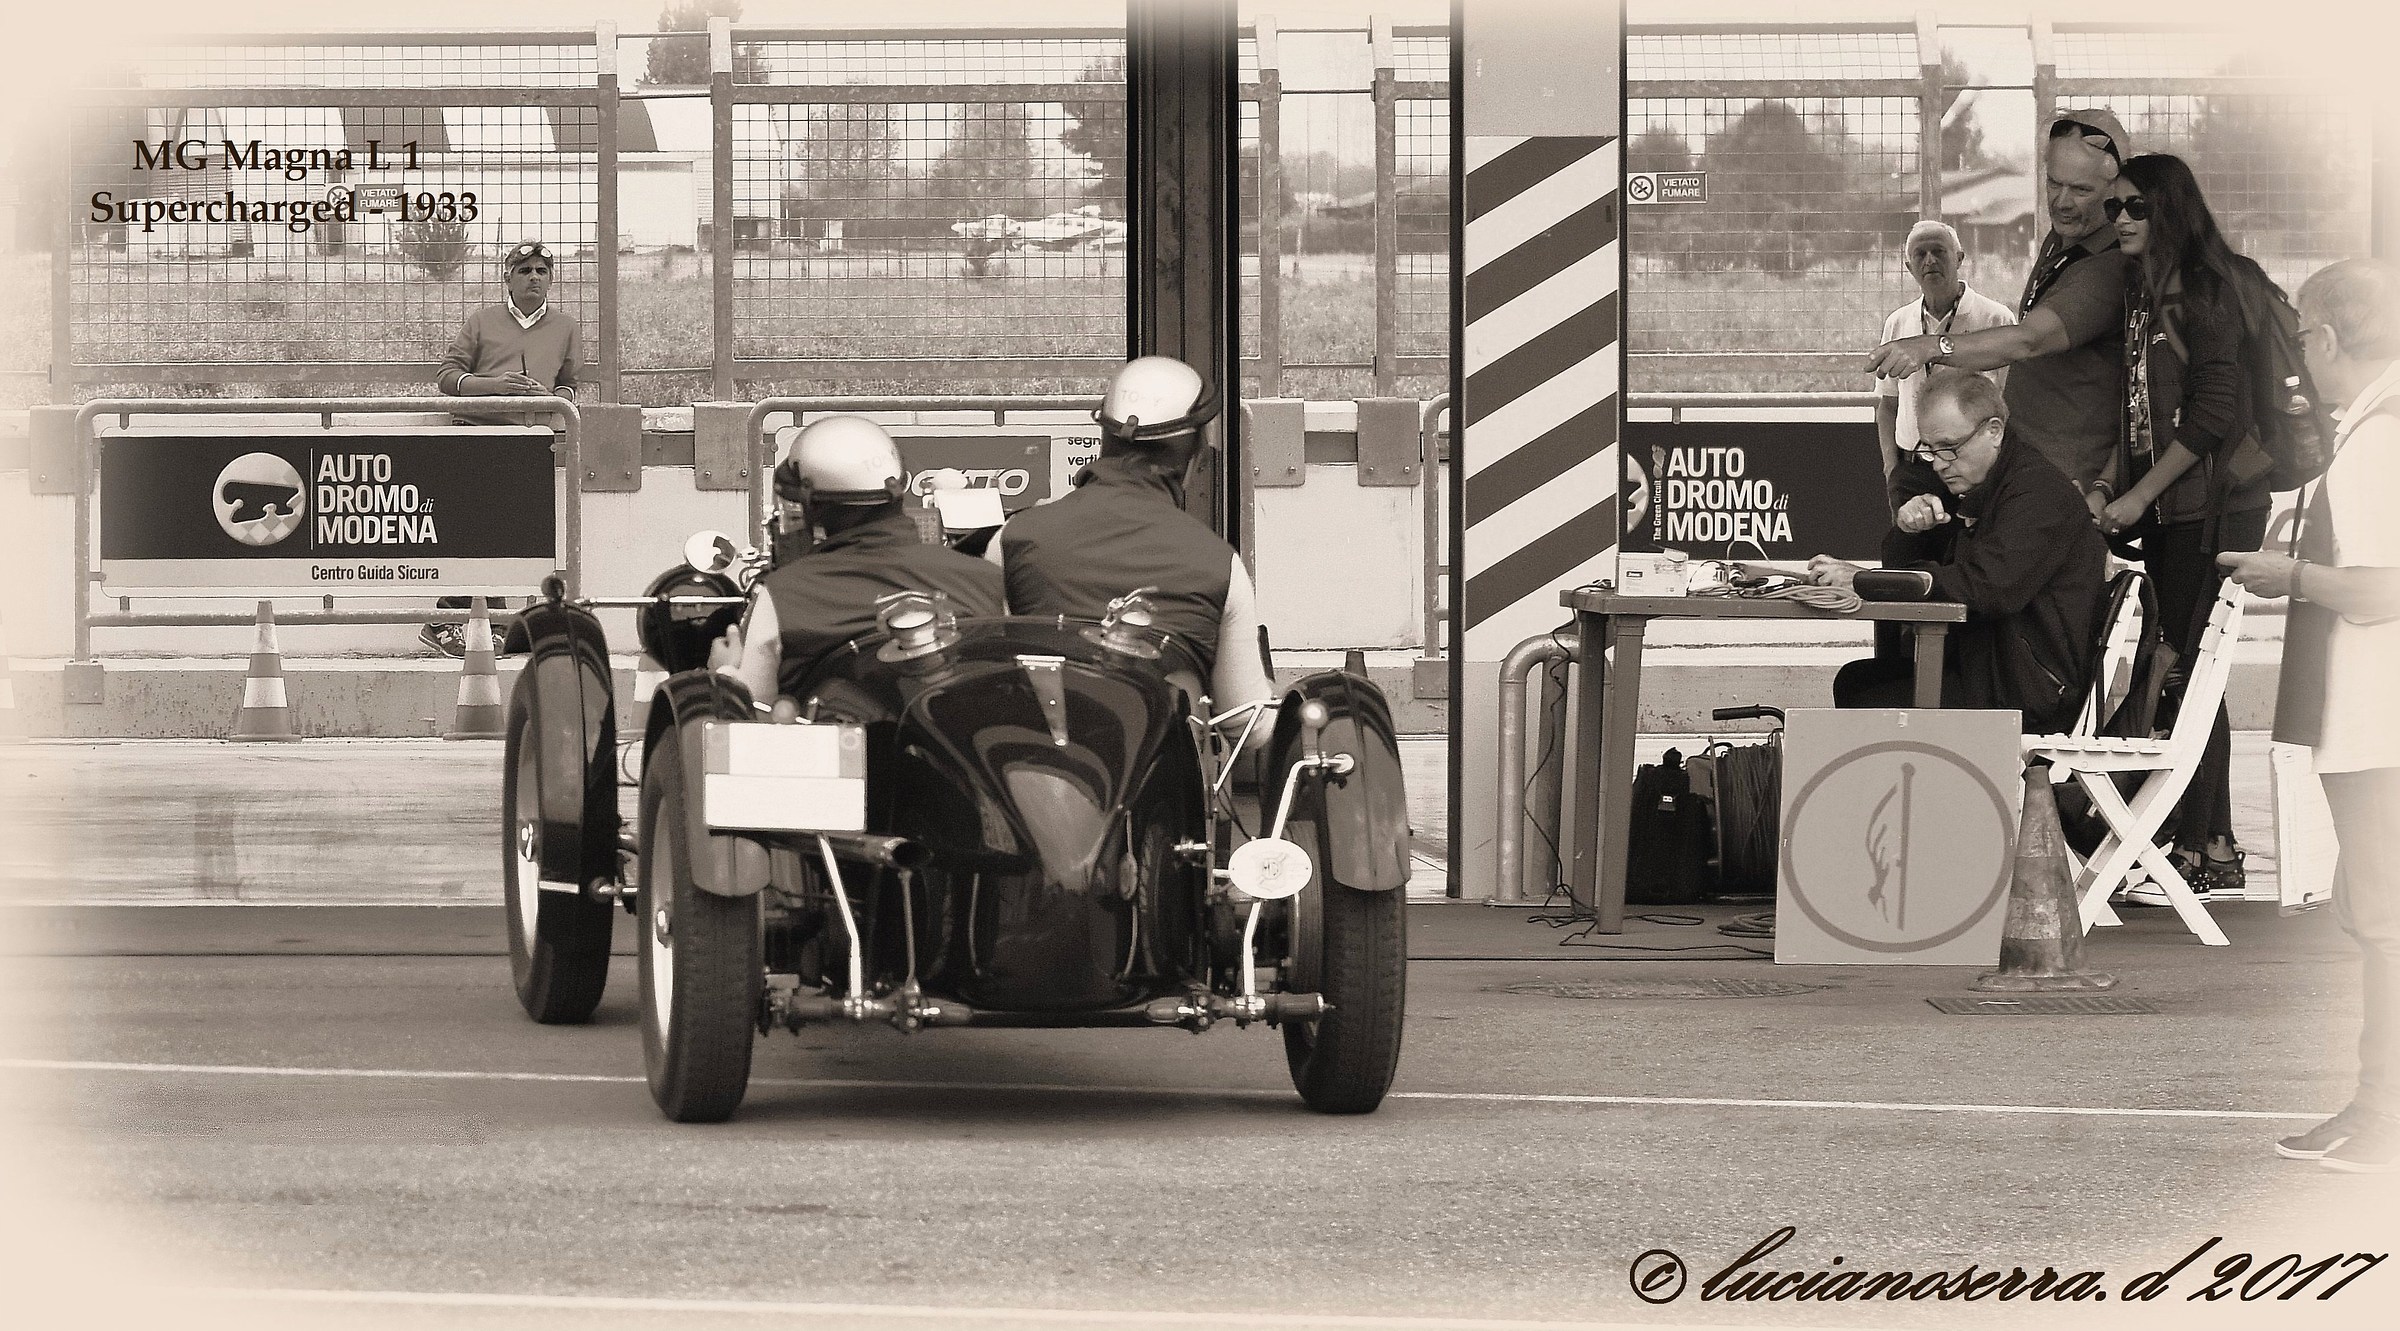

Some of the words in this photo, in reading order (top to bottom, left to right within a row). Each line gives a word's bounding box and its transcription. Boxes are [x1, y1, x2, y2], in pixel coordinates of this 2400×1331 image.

[360, 188, 398, 197] VIETATO
[1661, 188, 1700, 197] FUMARE
[1662, 177, 1700, 187] VIETATO
[359, 198, 399, 208] FUMARE
[317, 453, 392, 483] AUTO
[1667, 447, 1745, 478] AUTO
[317, 484, 419, 513] DROMO
[419, 498, 434, 513] di
[1667, 479, 1773, 510] DROMO
[1773, 493, 1789, 510] di
[1653, 504, 1662, 526] Green
[317, 515, 438, 544] MODENA
[1653, 527, 1662, 541] The
[1667, 511, 1793, 542] MODENA
[311, 564, 354, 581] Centro
[357, 564, 394, 581] Guida
[397, 564, 439, 581] Sicura
